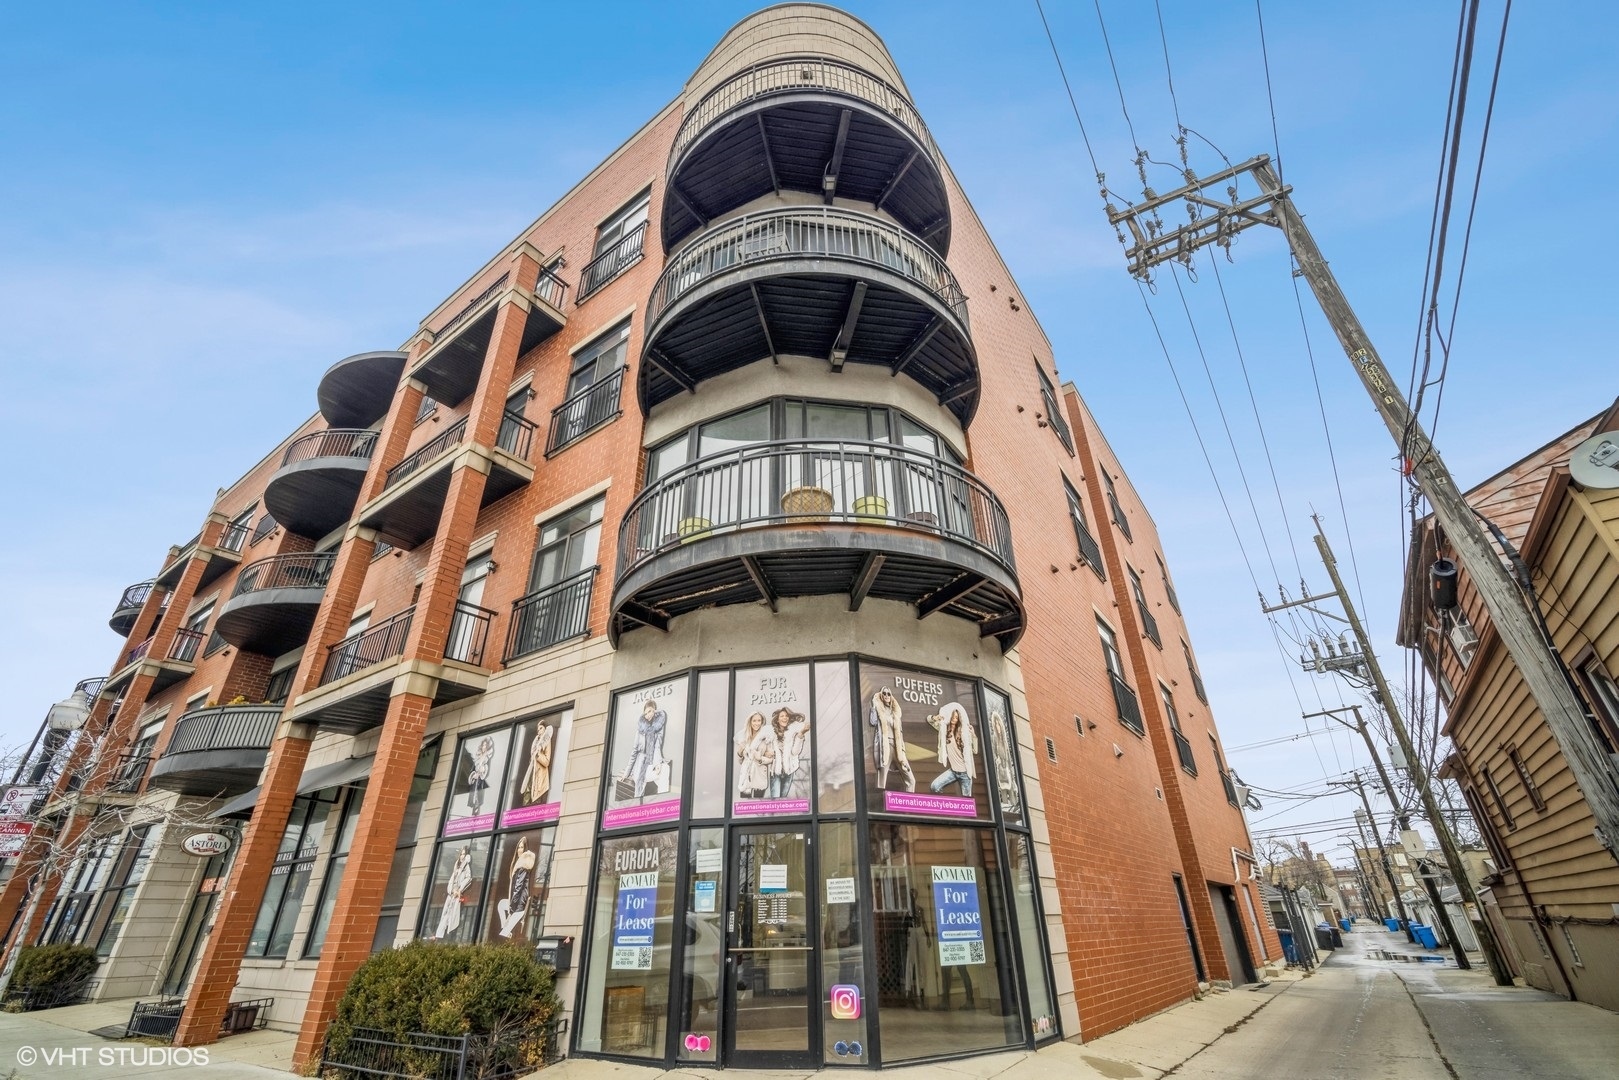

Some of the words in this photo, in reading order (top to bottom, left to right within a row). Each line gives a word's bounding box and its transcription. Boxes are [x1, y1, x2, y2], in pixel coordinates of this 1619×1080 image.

[759, 677, 787, 690] FUR
[894, 676, 943, 695] PUFFERS
[632, 684, 673, 704] JACKETS
[750, 690, 797, 706] PARKA
[902, 689, 939, 706] COATS
[188, 839, 227, 849] ASTORIA
[615, 847, 659, 871] EUROPA
[620, 874, 656, 888] KOMAR
[933, 868, 975, 881] KOMAR
[625, 894, 648, 910] For
[943, 887, 968, 904] For
[618, 914, 655, 930] Lease
[939, 908, 981, 925] Lease
